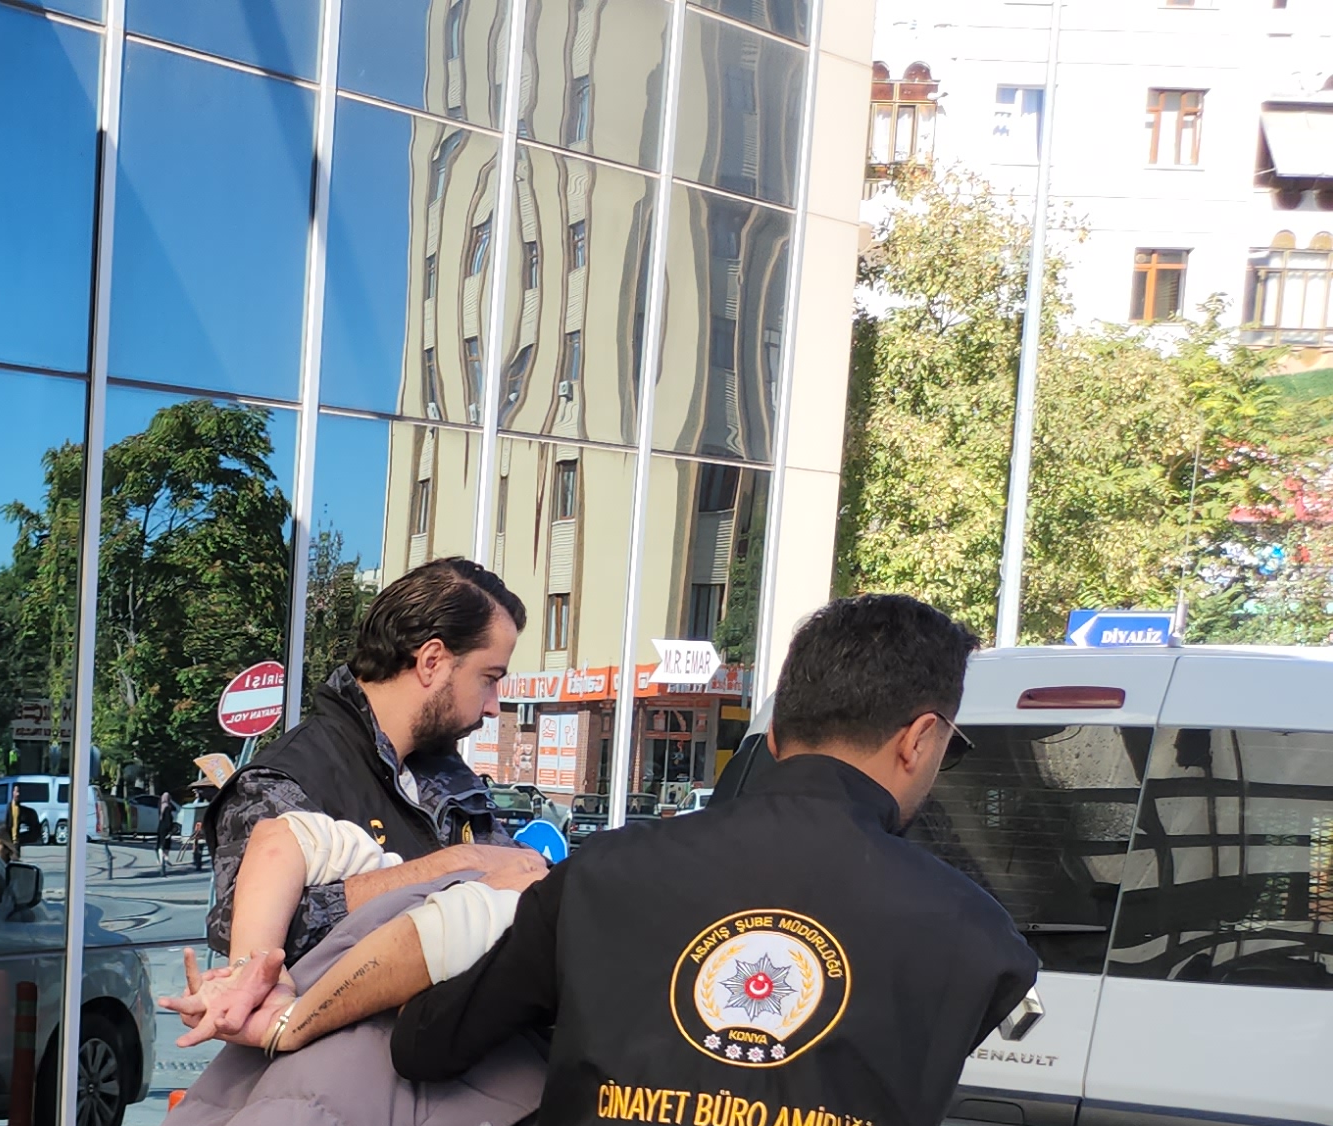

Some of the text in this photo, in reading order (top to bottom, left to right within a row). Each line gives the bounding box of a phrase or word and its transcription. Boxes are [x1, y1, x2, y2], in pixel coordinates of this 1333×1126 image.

[1100, 626, 1162, 645] DİYALİZ
[685, 650, 711, 674] EMAR
[689, 916, 844, 979] ASAYİŞ ŞUBE MÜDÜRLÜĞÜ
[728, 1029, 768, 1045] KONYA
[597, 1079, 691, 1126] CİNAYET
